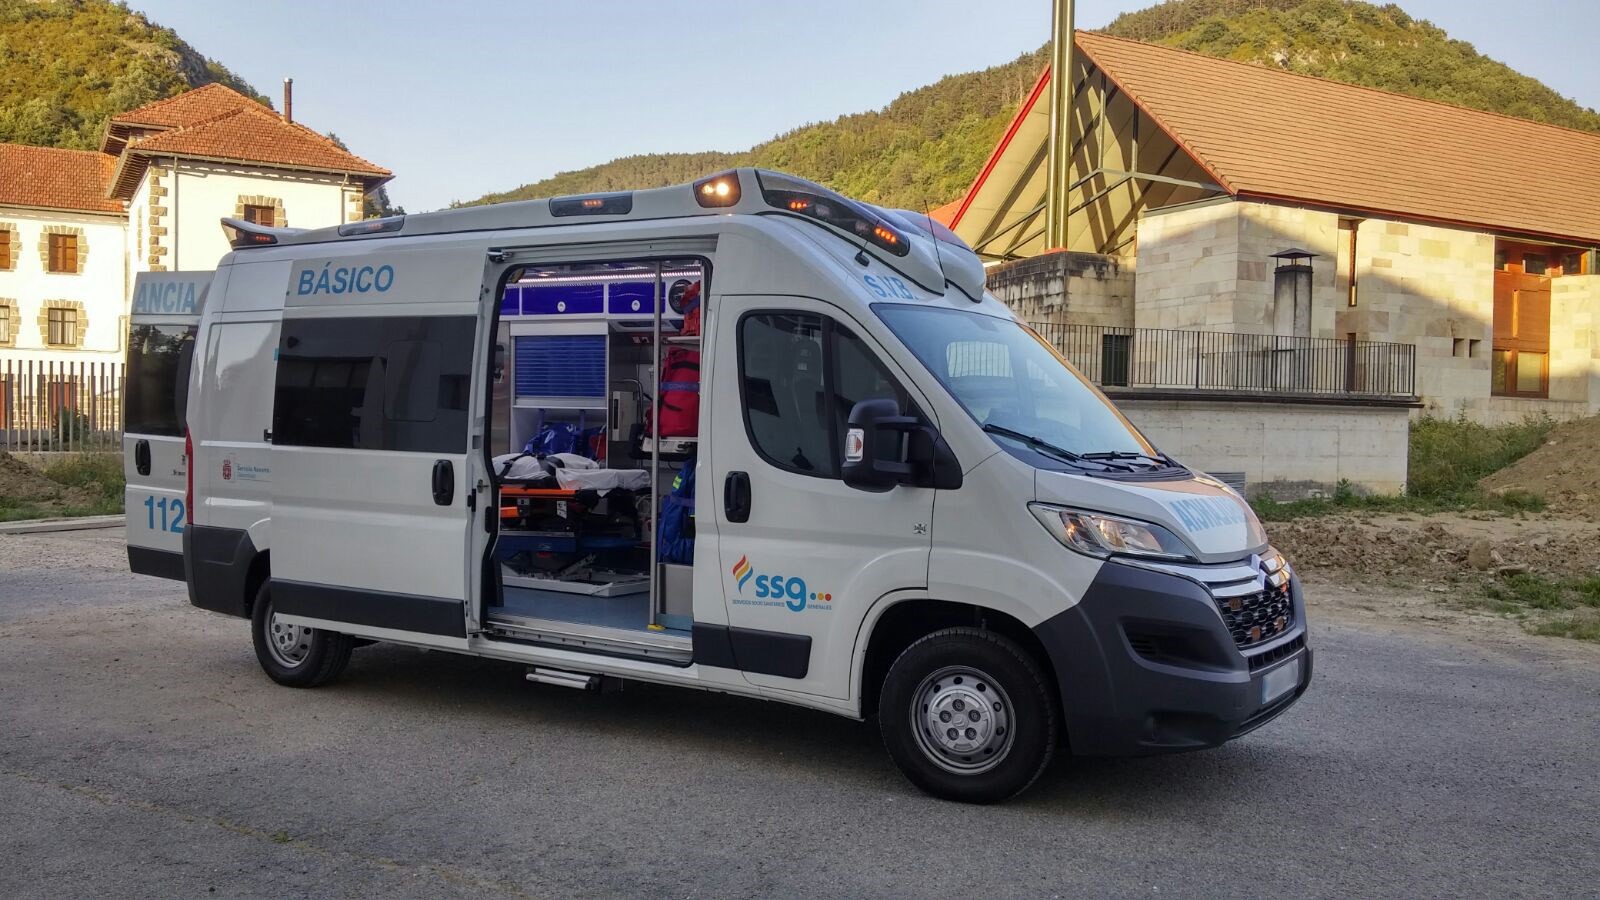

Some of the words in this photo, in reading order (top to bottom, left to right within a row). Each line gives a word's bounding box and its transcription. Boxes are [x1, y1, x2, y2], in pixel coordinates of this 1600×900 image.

[297, 261, 395, 296] BÁSICO
[134, 281, 196, 314] ANCIA
[144, 495, 185, 534] 112
